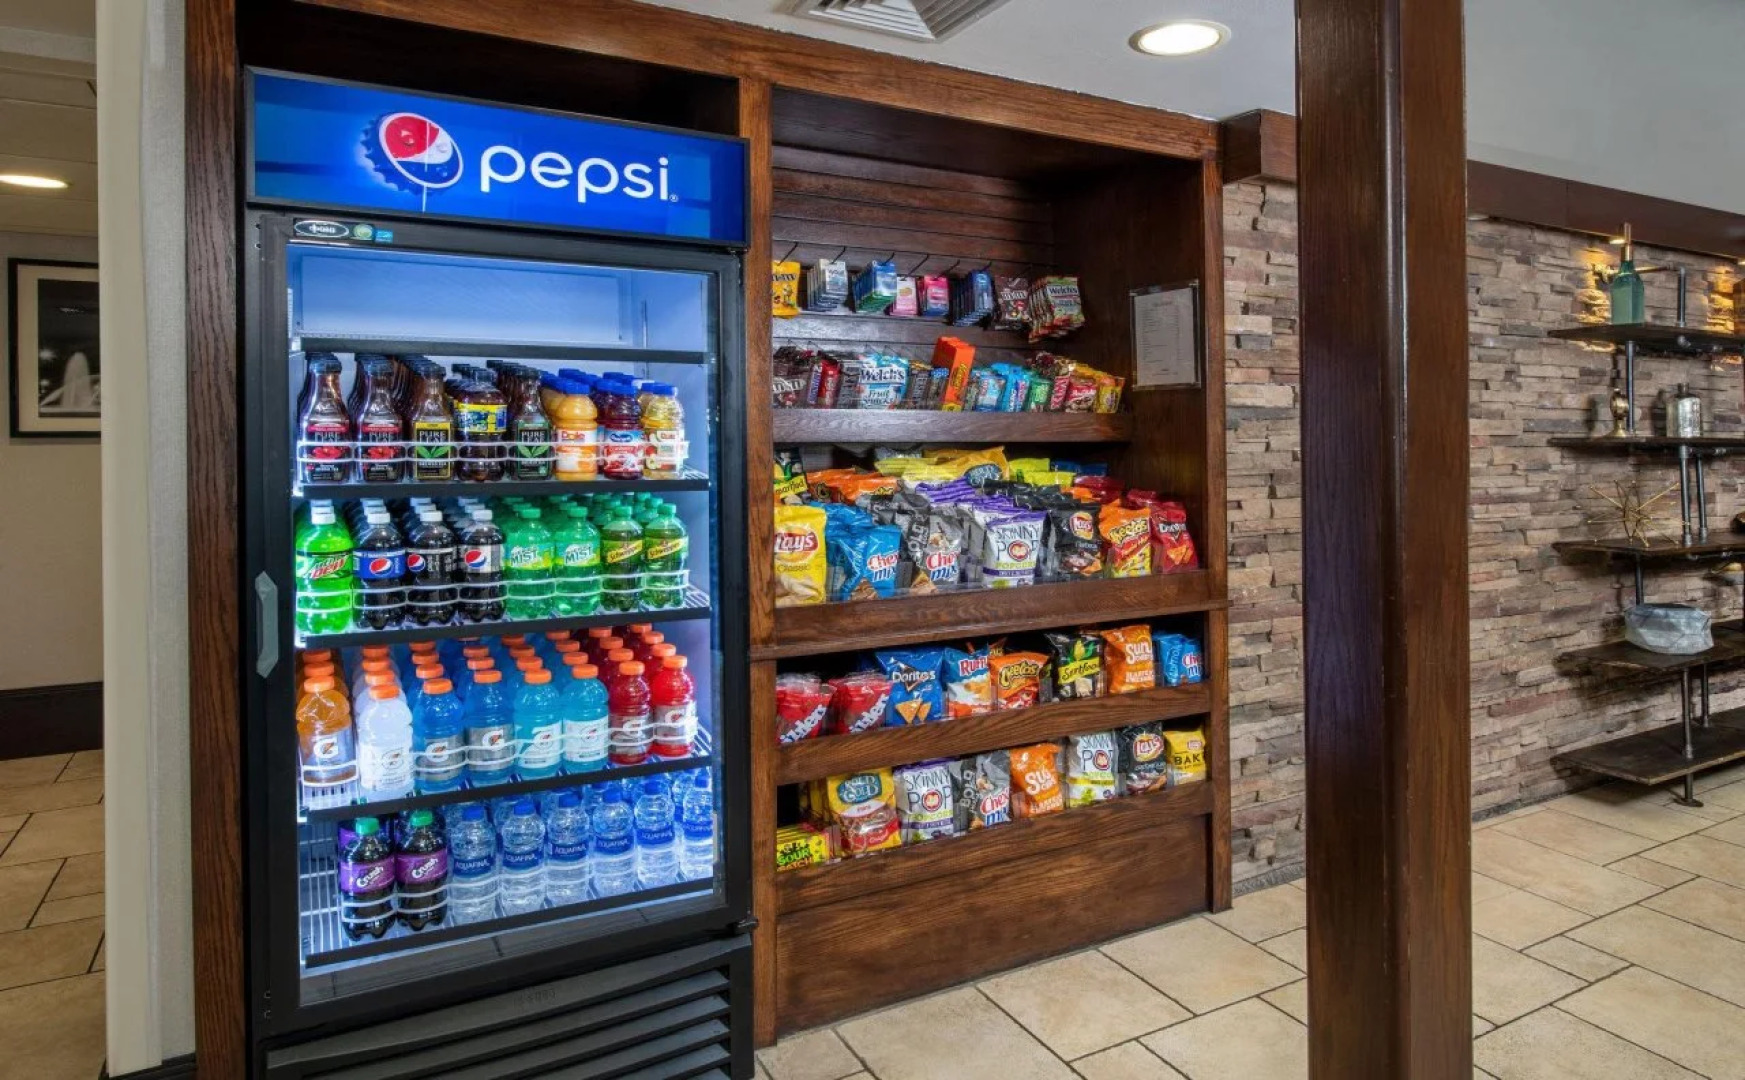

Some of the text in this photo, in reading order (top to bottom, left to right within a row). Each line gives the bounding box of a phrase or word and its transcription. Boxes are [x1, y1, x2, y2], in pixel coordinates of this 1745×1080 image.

[480, 145, 669, 203] pepsi
[1049, 286, 1078, 295] Welch's
[860, 367, 905, 381] Welch's
[868, 389, 890, 398] Fruit
[996, 524, 1040, 540] SKINNY
[774, 532, 815, 553] Lay's
[511, 549, 537, 564] MIST
[565, 547, 592, 564] MIST
[892, 670, 936, 682] Doritos
[1061, 662, 1097, 681] Smartfoo
[1134, 736, 1164, 755] Lay's
[904, 767, 951, 791] SKINNY
[959, 769, 974, 807] BOLD
[843, 784, 879, 803] GOLD
[455, 859, 490, 870] AQUAFINA
[777, 848, 811, 865] SOUR
[356, 866, 384, 888] Crush
[412, 858, 438, 879] Crush
